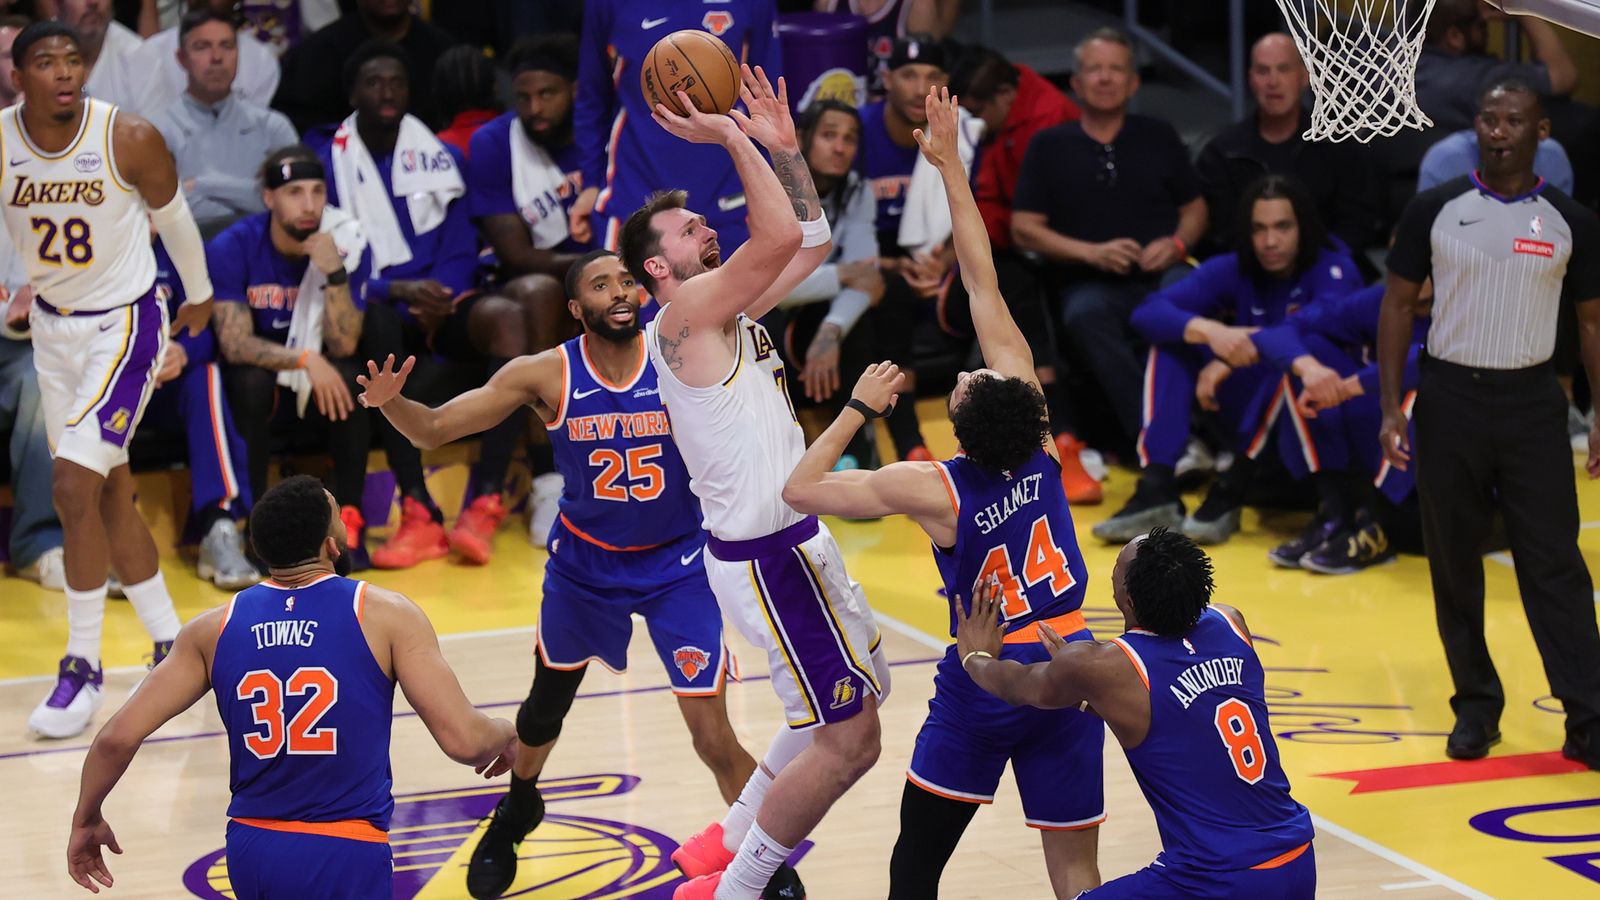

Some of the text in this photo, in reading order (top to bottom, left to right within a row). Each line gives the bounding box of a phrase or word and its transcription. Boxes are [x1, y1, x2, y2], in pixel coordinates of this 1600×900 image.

[8, 175, 105, 208] LAKERS
[31, 215, 95, 269] 28
[1514, 240, 1553, 255] Emirates
[589, 443, 665, 502] 25
[974, 472, 1042, 534] SHAMET
[972, 514, 1077, 621] 44
[251, 619, 318, 650] TOWNS
[1170, 657, 1243, 709] ANUNOBY
[236, 667, 338, 760] 32
[1214, 697, 1267, 785] 8
